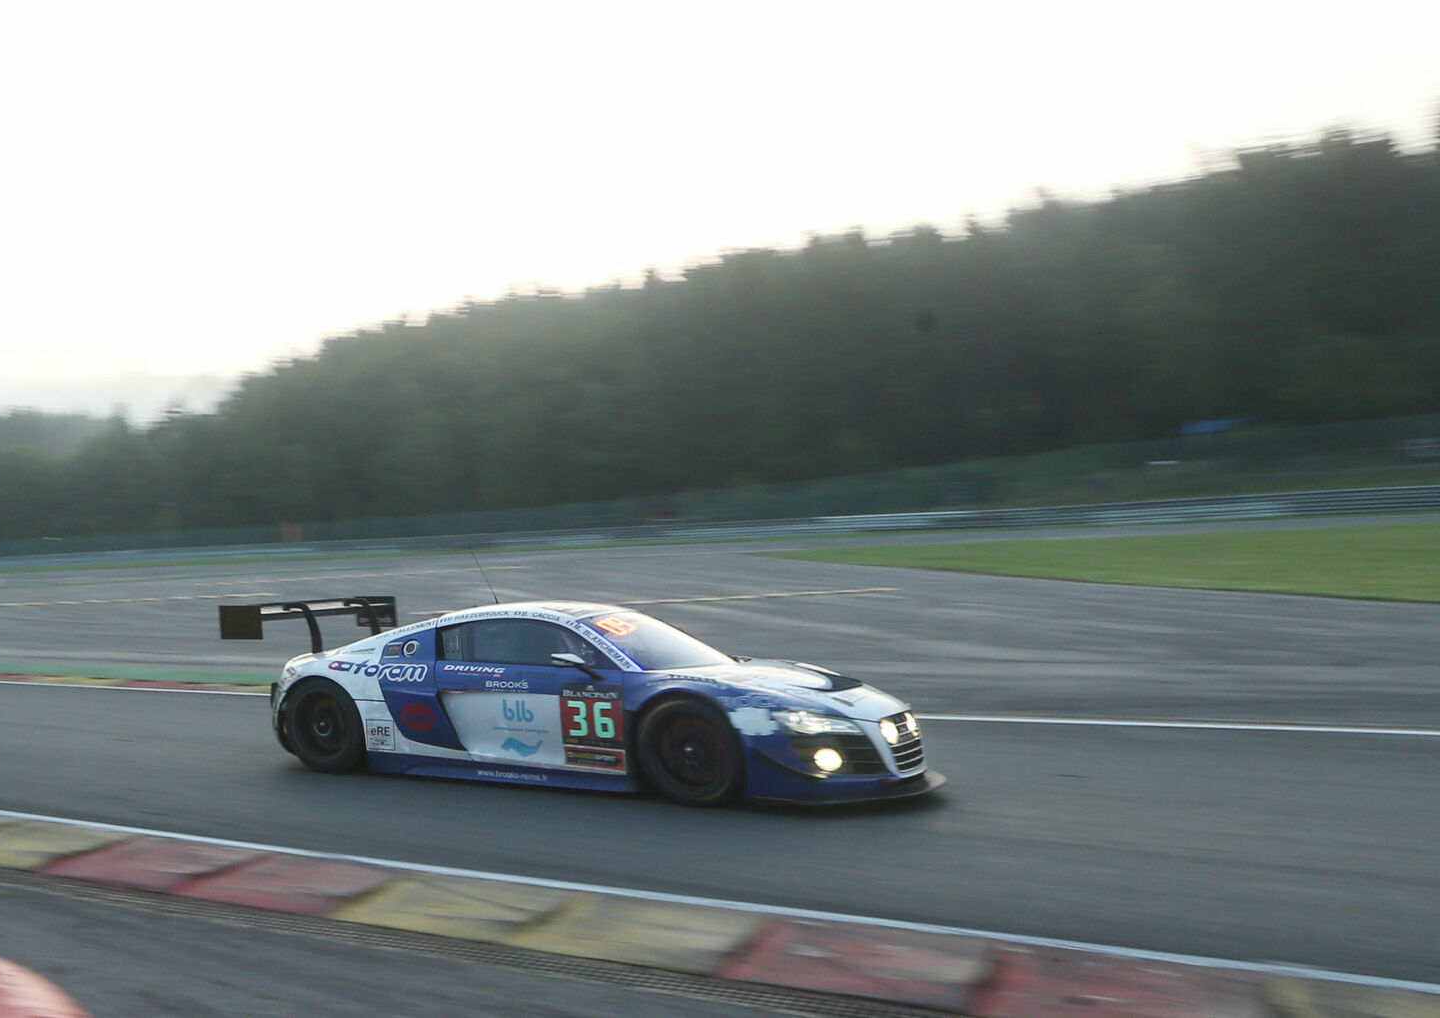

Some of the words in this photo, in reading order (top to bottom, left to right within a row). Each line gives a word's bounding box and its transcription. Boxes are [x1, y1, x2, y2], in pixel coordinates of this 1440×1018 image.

[531, 611, 561, 622] CACCIA
[443, 664, 506, 674] DRIVING
[562, 689, 619, 699] BLANCPAIN
[502, 698, 534, 723] blb
[566, 700, 616, 739] 36
[370, 726, 391, 737] eRE
